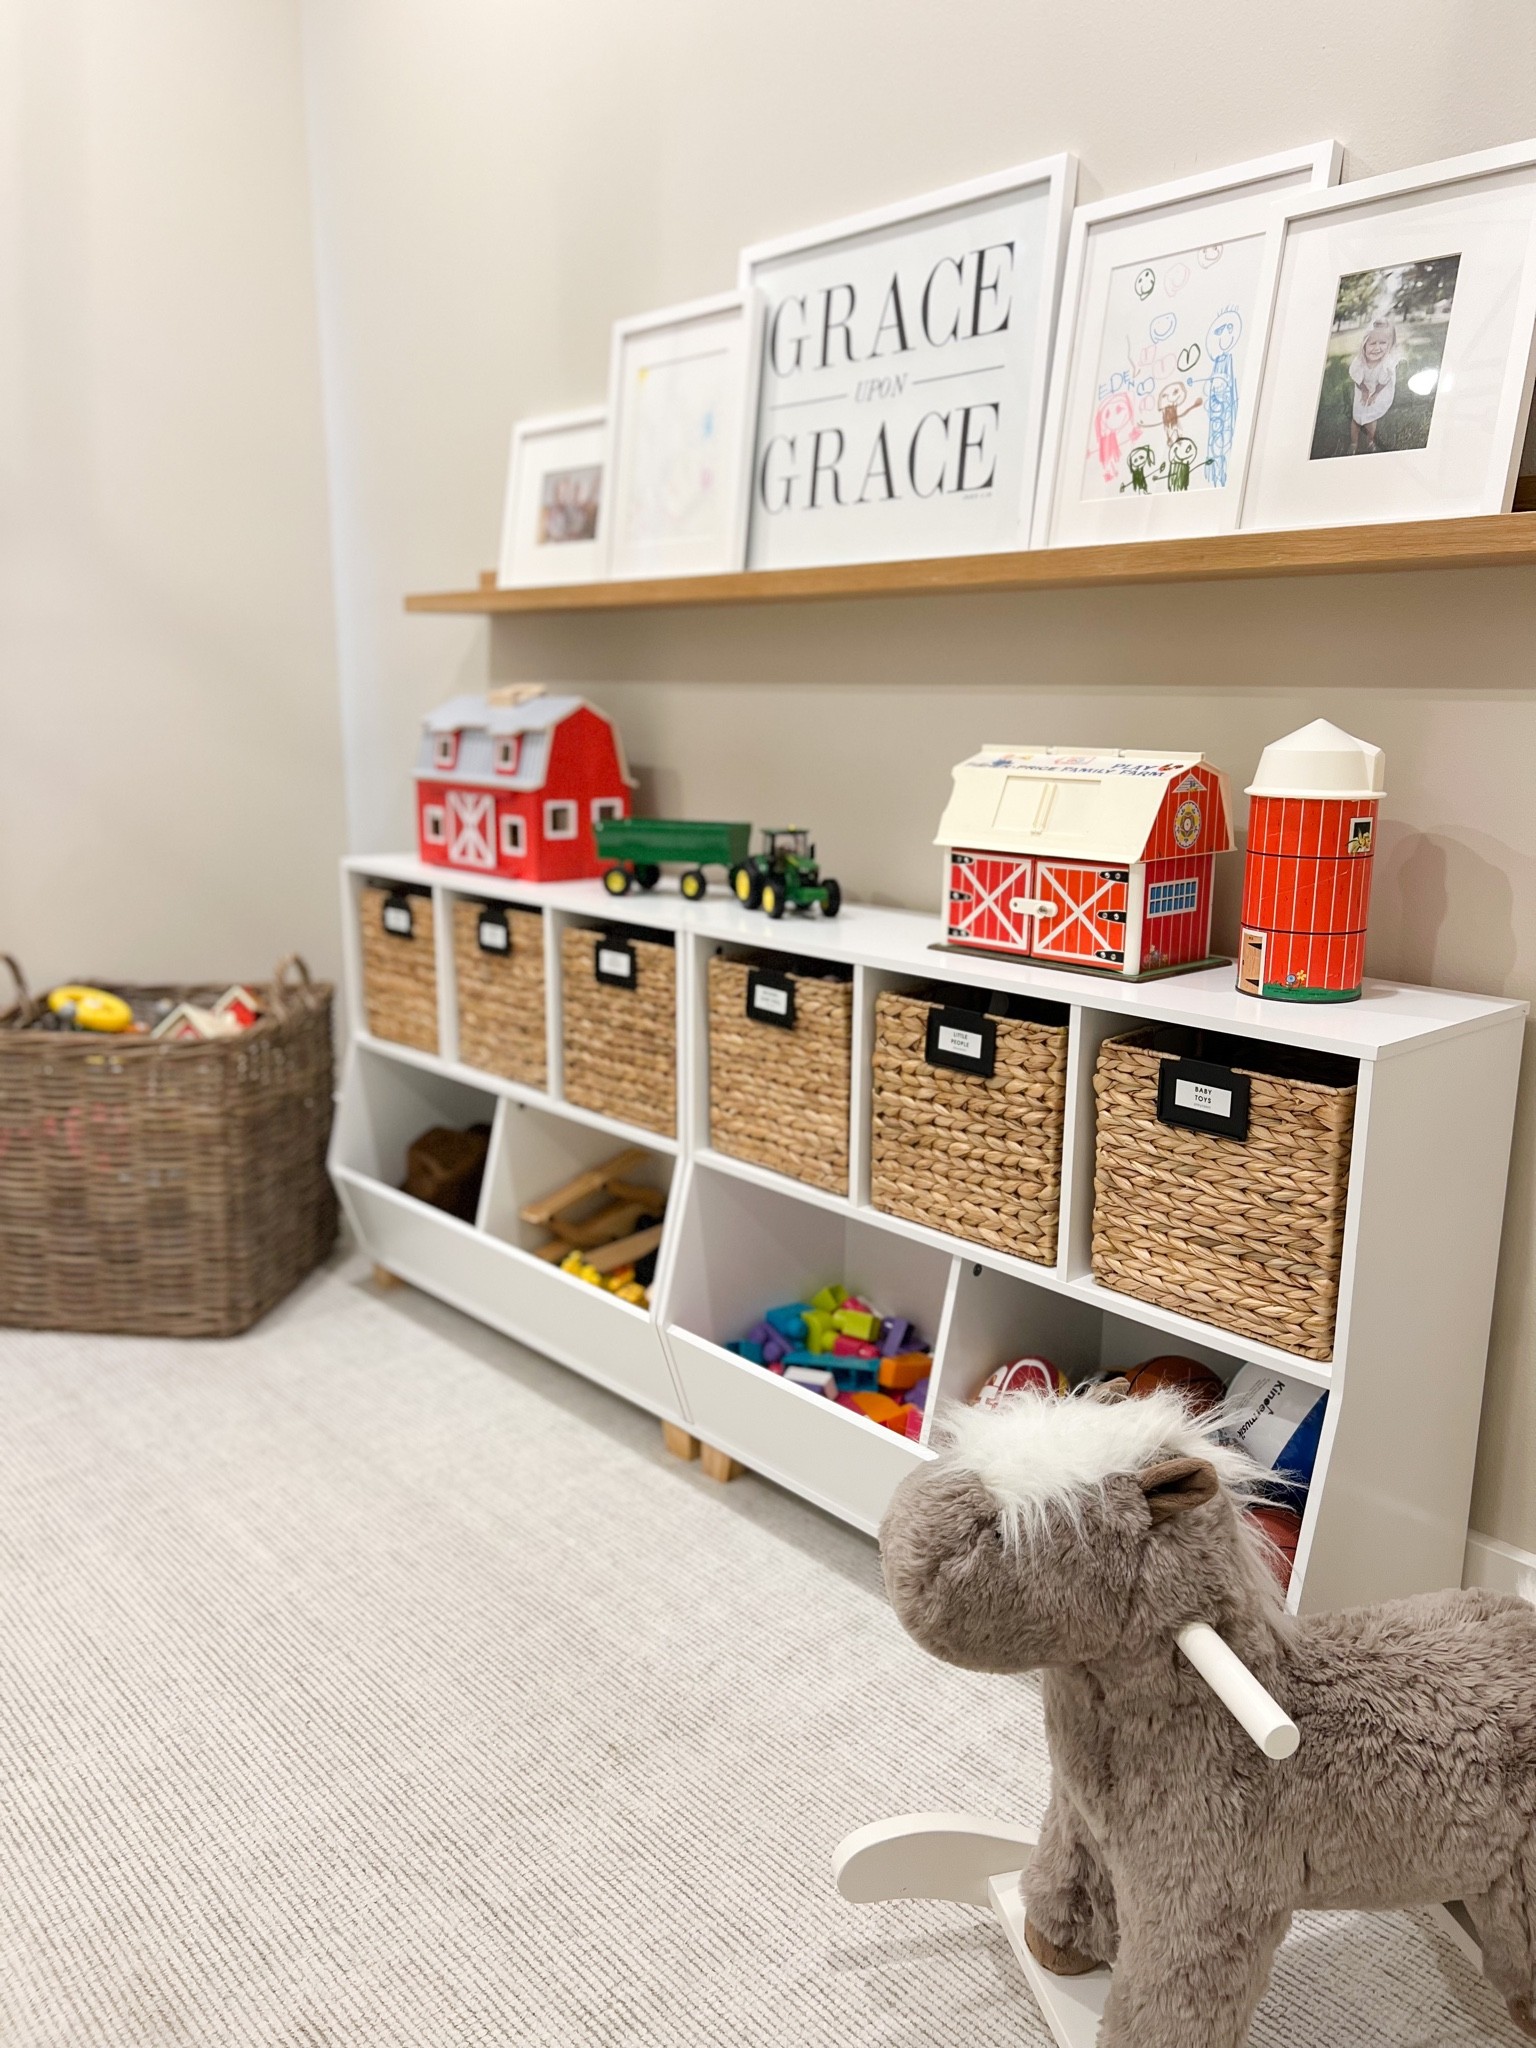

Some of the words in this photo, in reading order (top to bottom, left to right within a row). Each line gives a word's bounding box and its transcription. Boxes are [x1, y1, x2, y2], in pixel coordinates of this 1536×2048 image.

[770, 241, 1016, 379] GRACE
[854, 374, 909, 403] UPON
[1098, 369, 1135, 401] EDEN
[760, 402, 1000, 515] GRACE
[1060, 766, 1116, 774] FAMILY
[1119, 769, 1165, 777] FARM
[951, 1039, 969, 1047] PEOPLE
[1195, 1087, 1212, 1095] BABY
[1195, 1095, 1211, 1103] TOYS
[1237, 1380, 1285, 1440] Kindermusik
